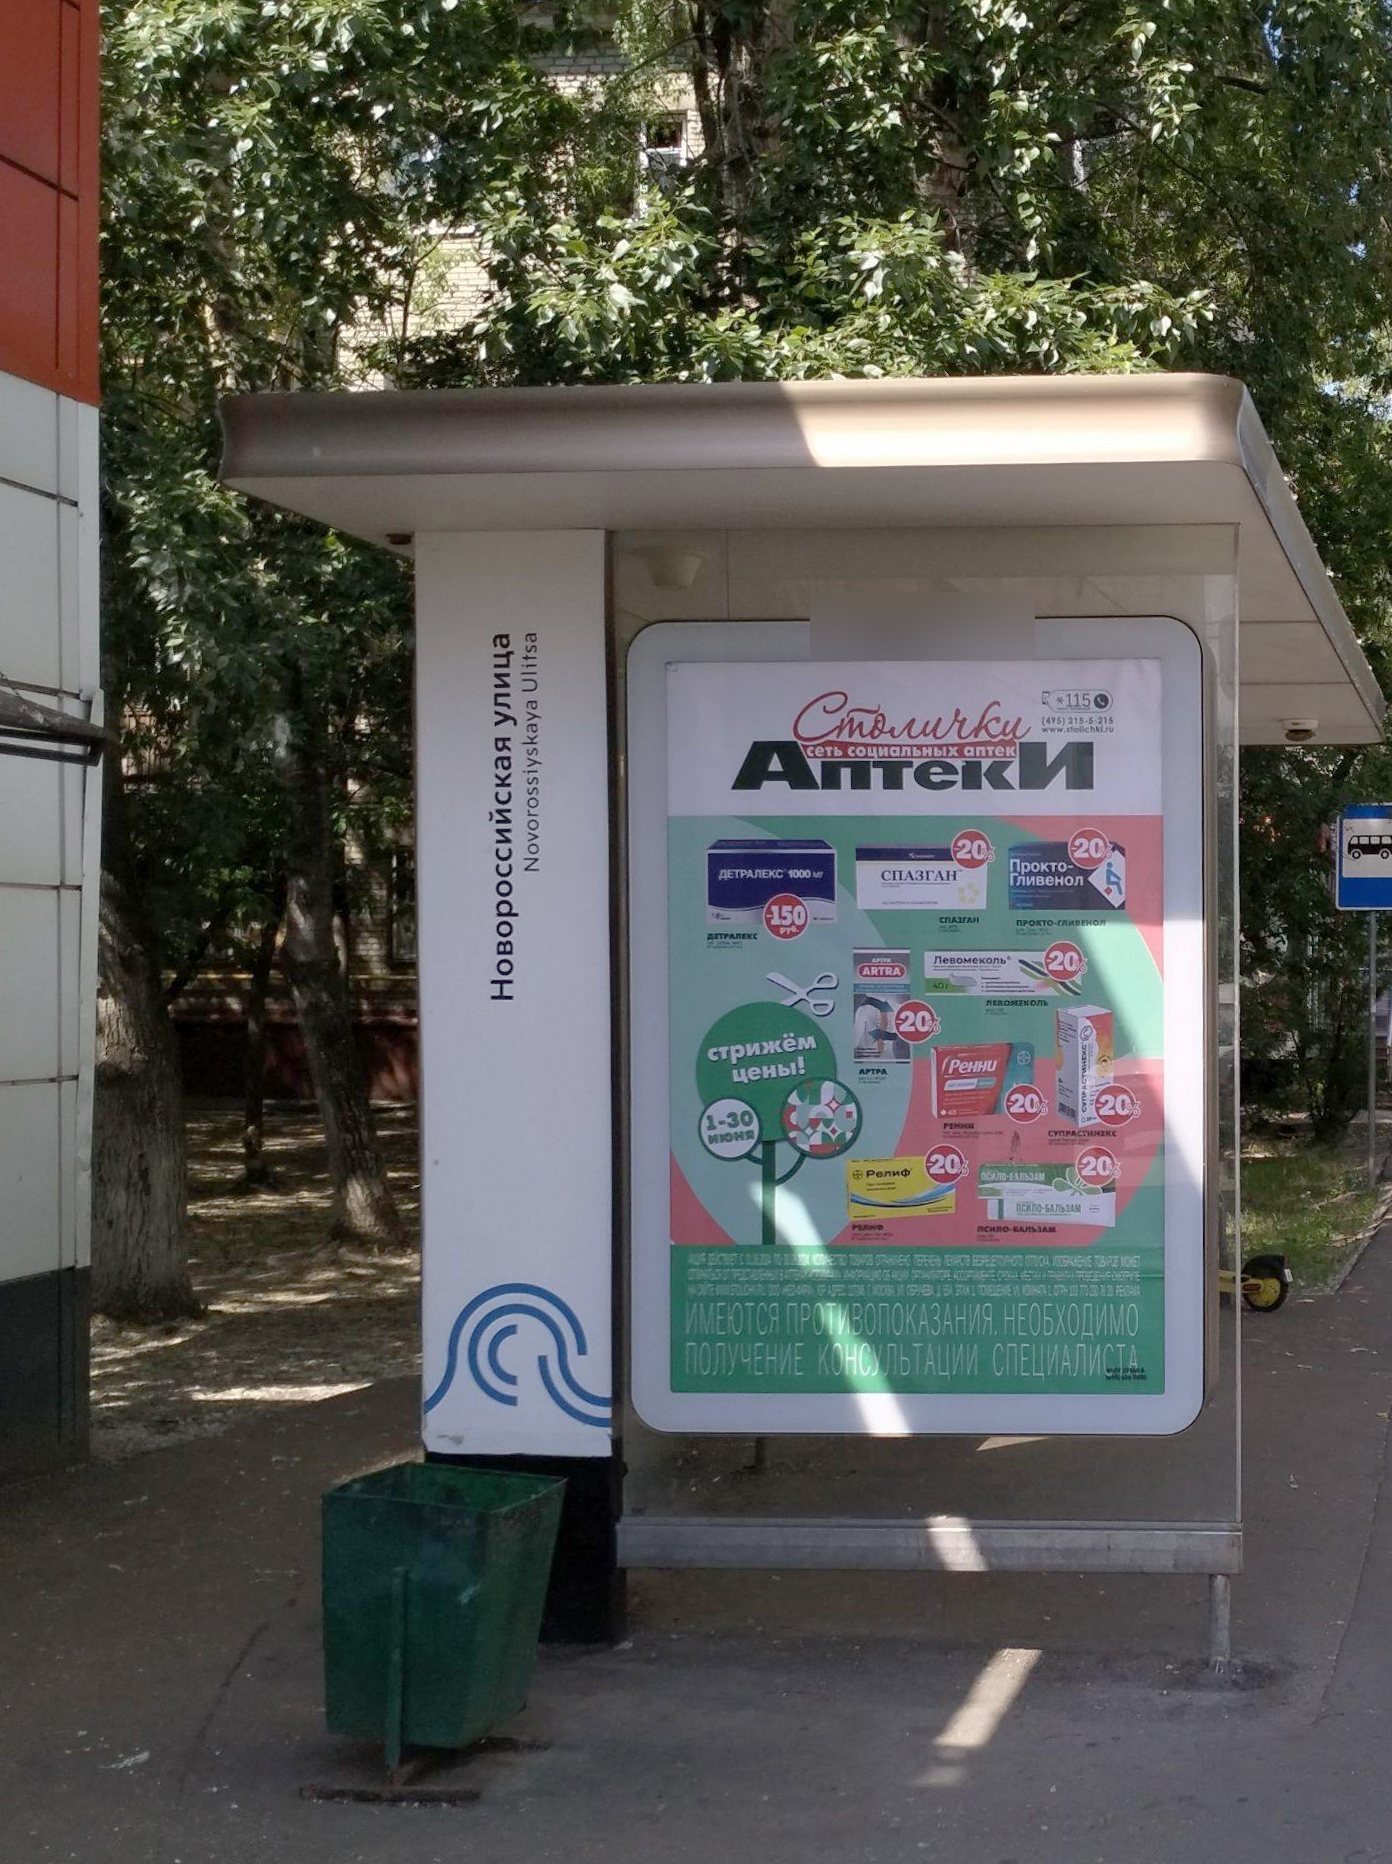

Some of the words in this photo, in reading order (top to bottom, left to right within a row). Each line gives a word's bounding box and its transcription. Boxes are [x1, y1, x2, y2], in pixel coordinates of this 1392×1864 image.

[521, 632, 538, 693] Ulitsa
[492, 633, 517, 728] улица
[792, 691, 1031, 743] Столички
[806, 745, 843, 758] сеть
[848, 744, 961, 759] социальных
[964, 744, 1016, 757] аптек
[521, 700, 543, 872] Novorossiyskaya
[489, 736, 519, 1000] Новороссийская
[719, 869, 784, 880] ДЕТРАЛЕКС
[787, 869, 811, 878] 1000
[881, 870, 957, 881] СПАЗГАН
[1010, 859, 1074, 875] Прокто-
[1010, 873, 1084, 886] Гливенол
[765, 905, 806, 926] -150
[861, 966, 902, 976] ARTRA
[985, 999, 1048, 1007] ЛЕВОМЕКОЛЬ
[707, 1032, 817, 1064] стрижём
[732, 1056, 806, 1084] цены!
[949, 1059, 997, 1074] Ренни
[706, 1110, 754, 1131] 1-30
[866, 1168, 911, 1178] Релиф
[981, 1172, 1045, 1181] ПСИЛО-БАЛЬЗАМ
[1016, 1203, 1081, 1213] ПСИЛО-БАЛЬЗАМ
[686, 1303, 779, 1336] ИМЕЮТСЯ
[1004, 1303, 1139, 1340] НЕОБХОДИМО
[685, 1343, 804, 1375] ПОЛУЧЕНИЕ
[819, 1343, 978, 1380] КОНСУЛЬТАЦИИ
[993, 1343, 1138, 1381] СПЕЦИАЛИСТА
